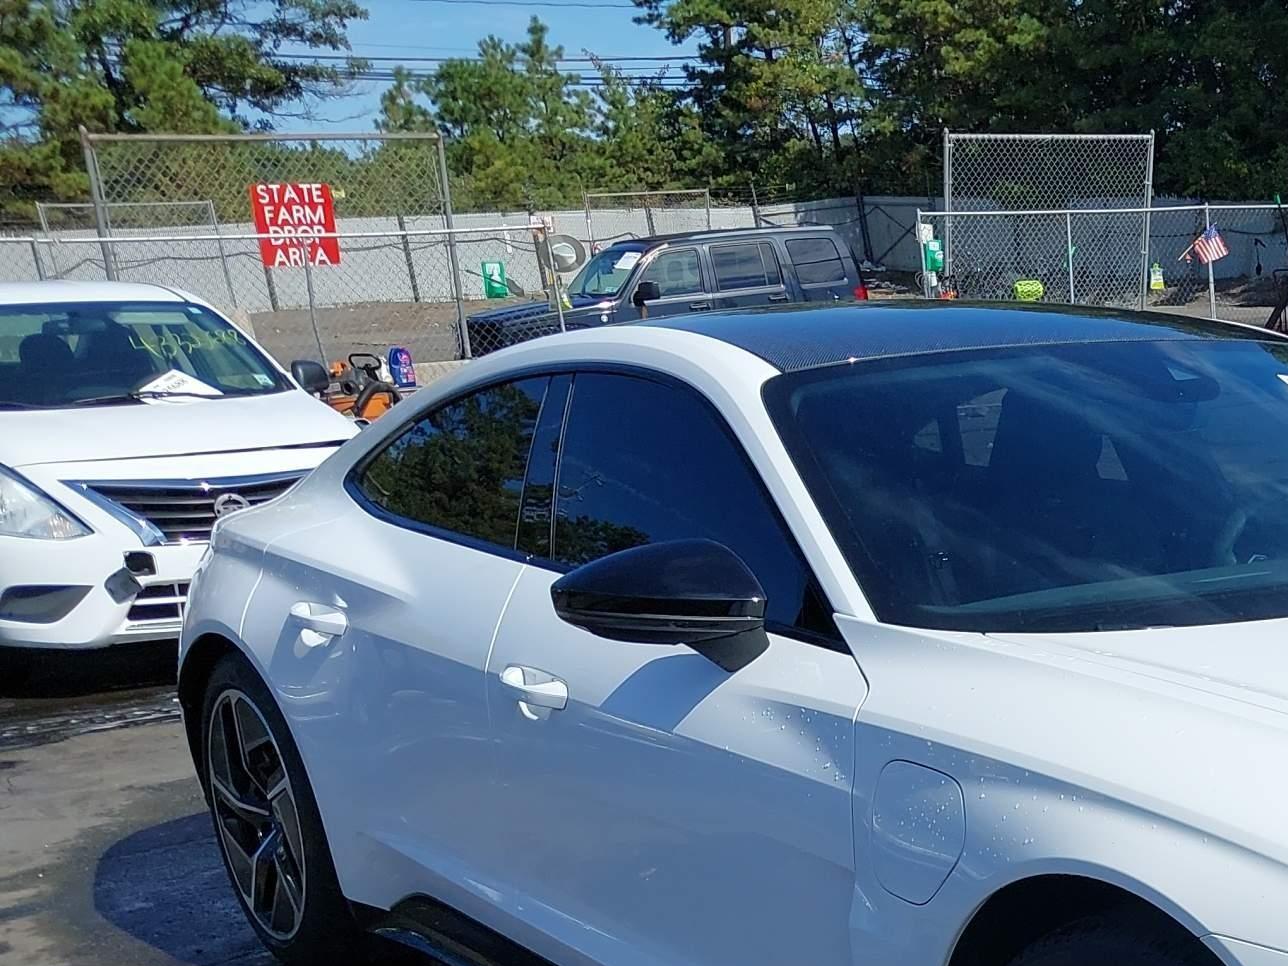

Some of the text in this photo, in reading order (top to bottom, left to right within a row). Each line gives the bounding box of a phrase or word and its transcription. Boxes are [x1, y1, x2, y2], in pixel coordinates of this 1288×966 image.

[256, 183, 325, 203] STATE
[263, 204, 326, 225] FARM
[268, 225, 326, 246] DROP
[274, 246, 332, 267] AREA
